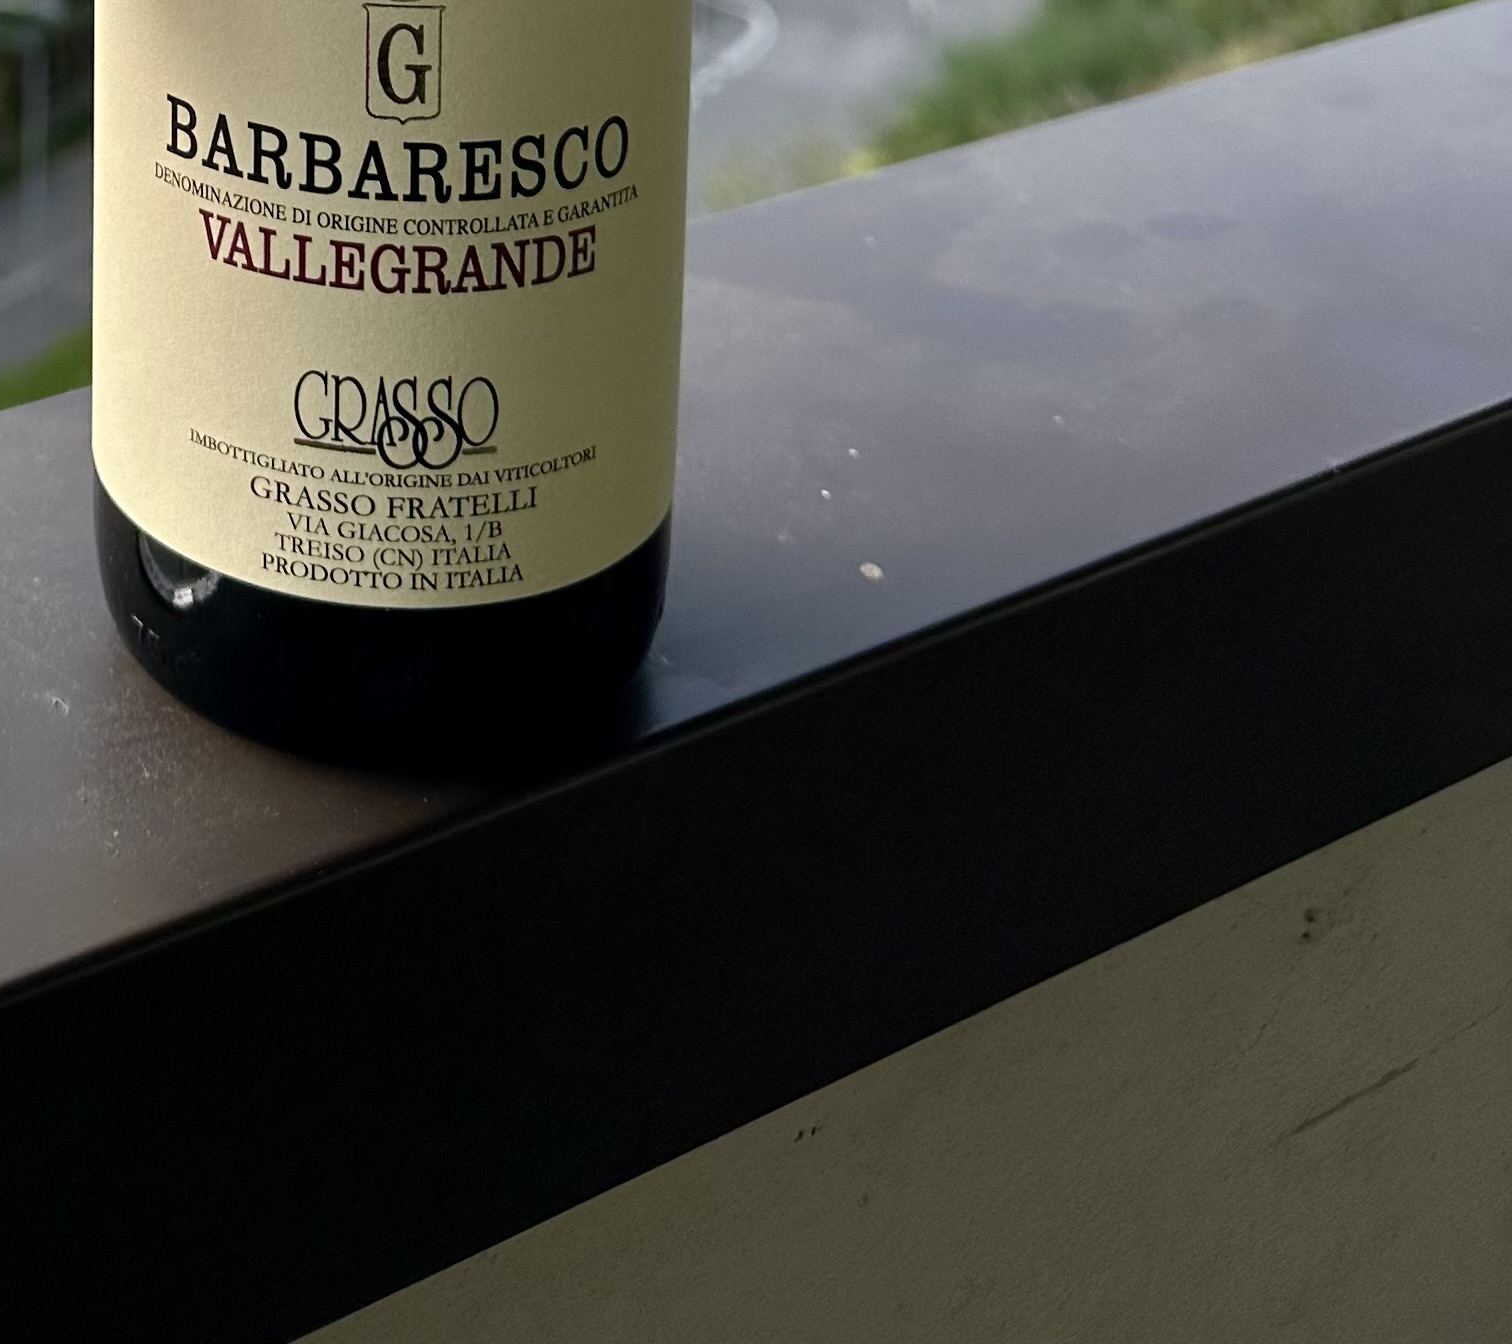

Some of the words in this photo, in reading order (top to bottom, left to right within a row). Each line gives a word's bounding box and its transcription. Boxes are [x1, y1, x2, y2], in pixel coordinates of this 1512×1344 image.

[377, 22, 432, 105] G
[166, 93, 629, 204] BARBARESCO
[155, 161, 287, 222] DENOMINAZIONE
[292, 207, 312, 226] DI
[317, 211, 399, 235] ORIGINE
[403, 213, 539, 236] CONTROLLATA
[542, 209, 554, 226] E
[557, 184, 639, 223] GARANTITA
[198, 207, 596, 295] VALLEGRANDE
[294, 370, 499, 470] GRASSO
[189, 428, 325, 480] IMBOTTIGLIATO
[329, 468, 453, 488] ALL'ORIGINE
[457, 471, 490, 487] DAI
[494, 445, 597, 483] VITICOLTORI
[250, 475, 376, 517] GRASSO
[387, 486, 538, 519] FRATELLI
[286, 511, 330, 536] VIA
[337, 521, 456, 545] GIACOSA,
[465, 519, 503, 543] 1/B
[261, 552, 403, 590] PRODOTTO
[409, 572, 438, 591] IN
[447, 563, 524, 590] ITALIA
[274, 531, 365, 563] TREISO
[373, 548, 423, 571] (CN)
[431, 542, 512, 567] ITALIA
